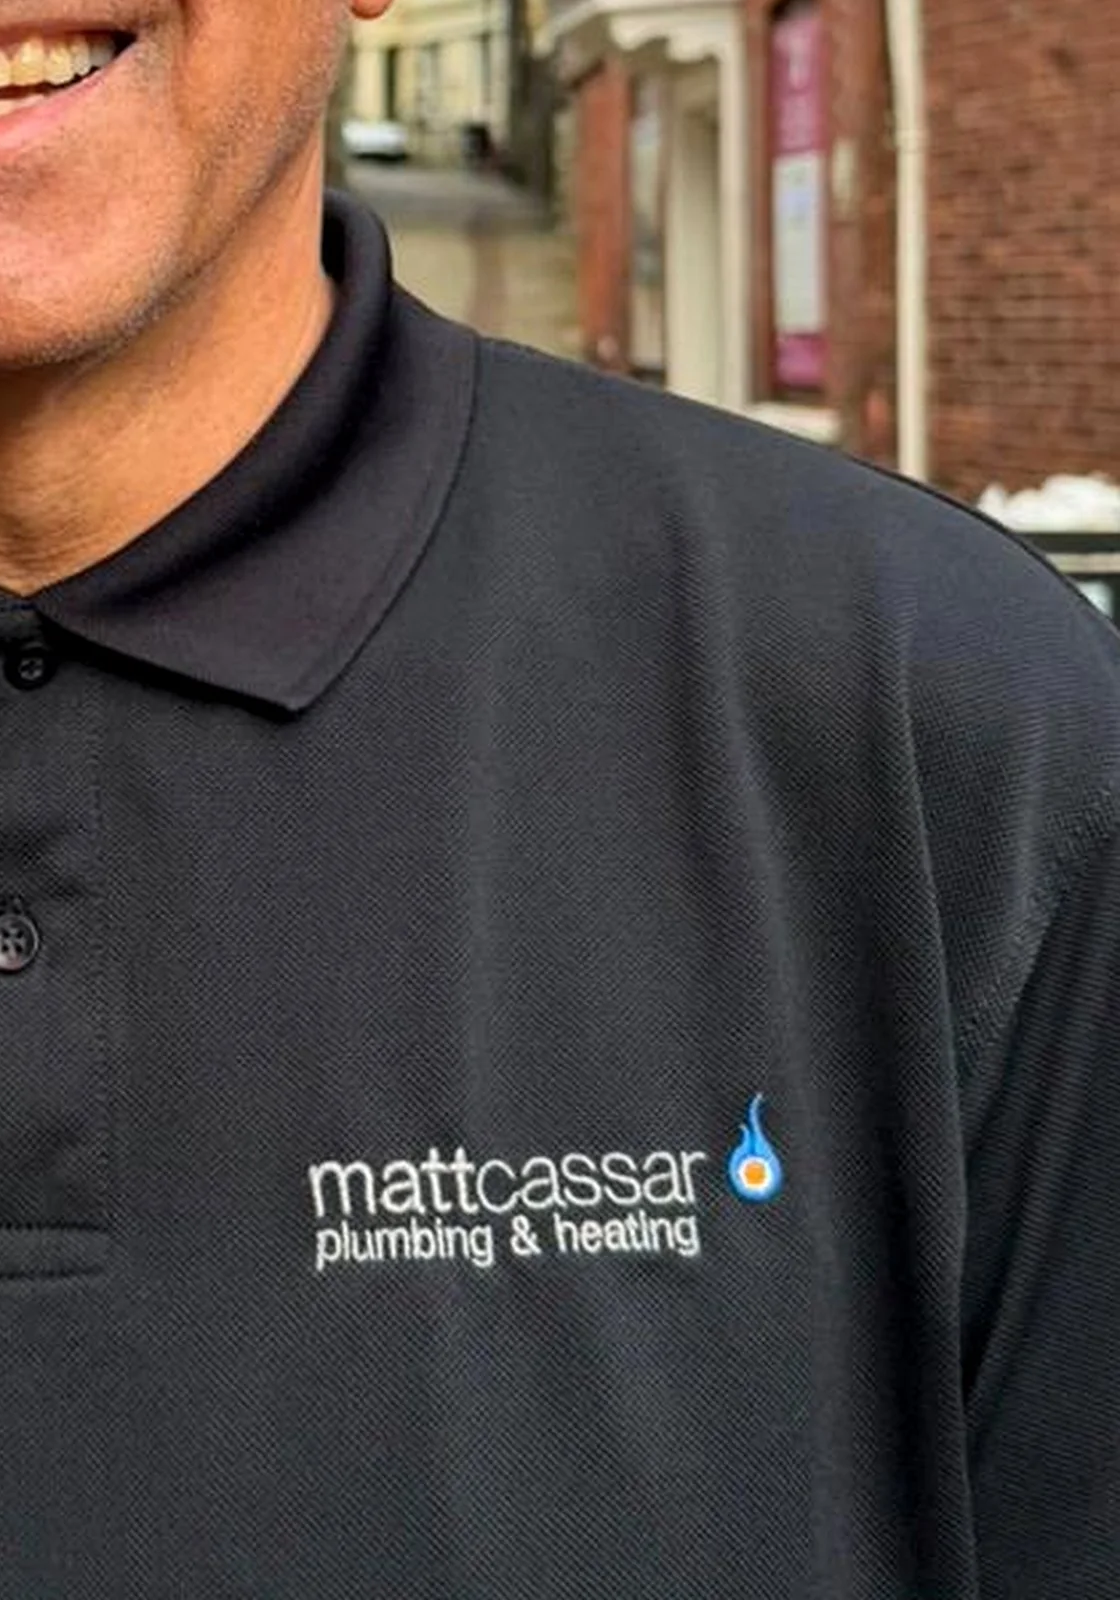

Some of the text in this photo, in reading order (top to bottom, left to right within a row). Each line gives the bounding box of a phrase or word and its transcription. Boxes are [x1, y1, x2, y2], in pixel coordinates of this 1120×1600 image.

[315, 1211, 701, 1271] plumbing & heating
